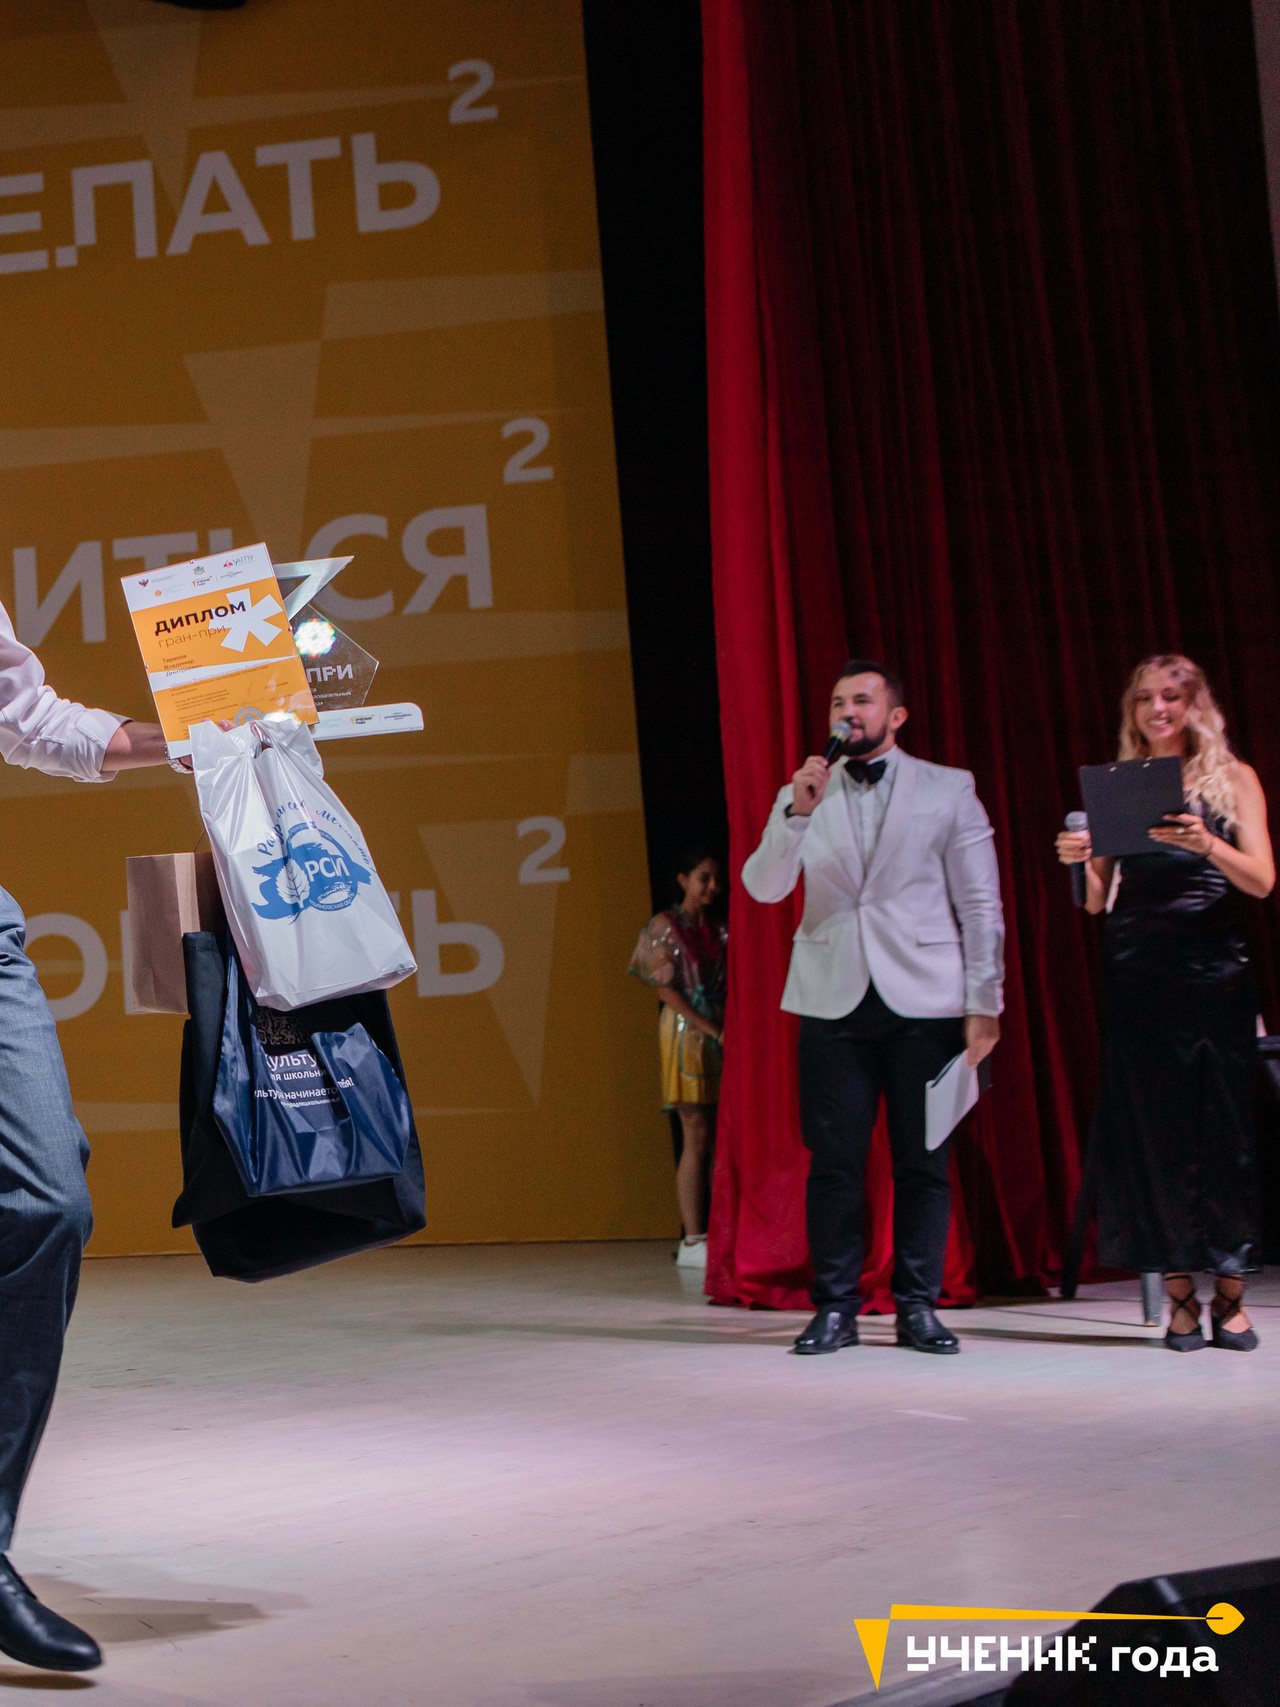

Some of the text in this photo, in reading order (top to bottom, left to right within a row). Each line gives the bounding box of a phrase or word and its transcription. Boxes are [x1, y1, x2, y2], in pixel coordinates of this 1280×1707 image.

[446, 58, 499, 125] 2
[502, 416, 555, 484] 2
[154, 600, 247, 636] ДИПЛОМ
[158, 625, 226, 649] гран-при
[517, 815, 570, 885] 2
